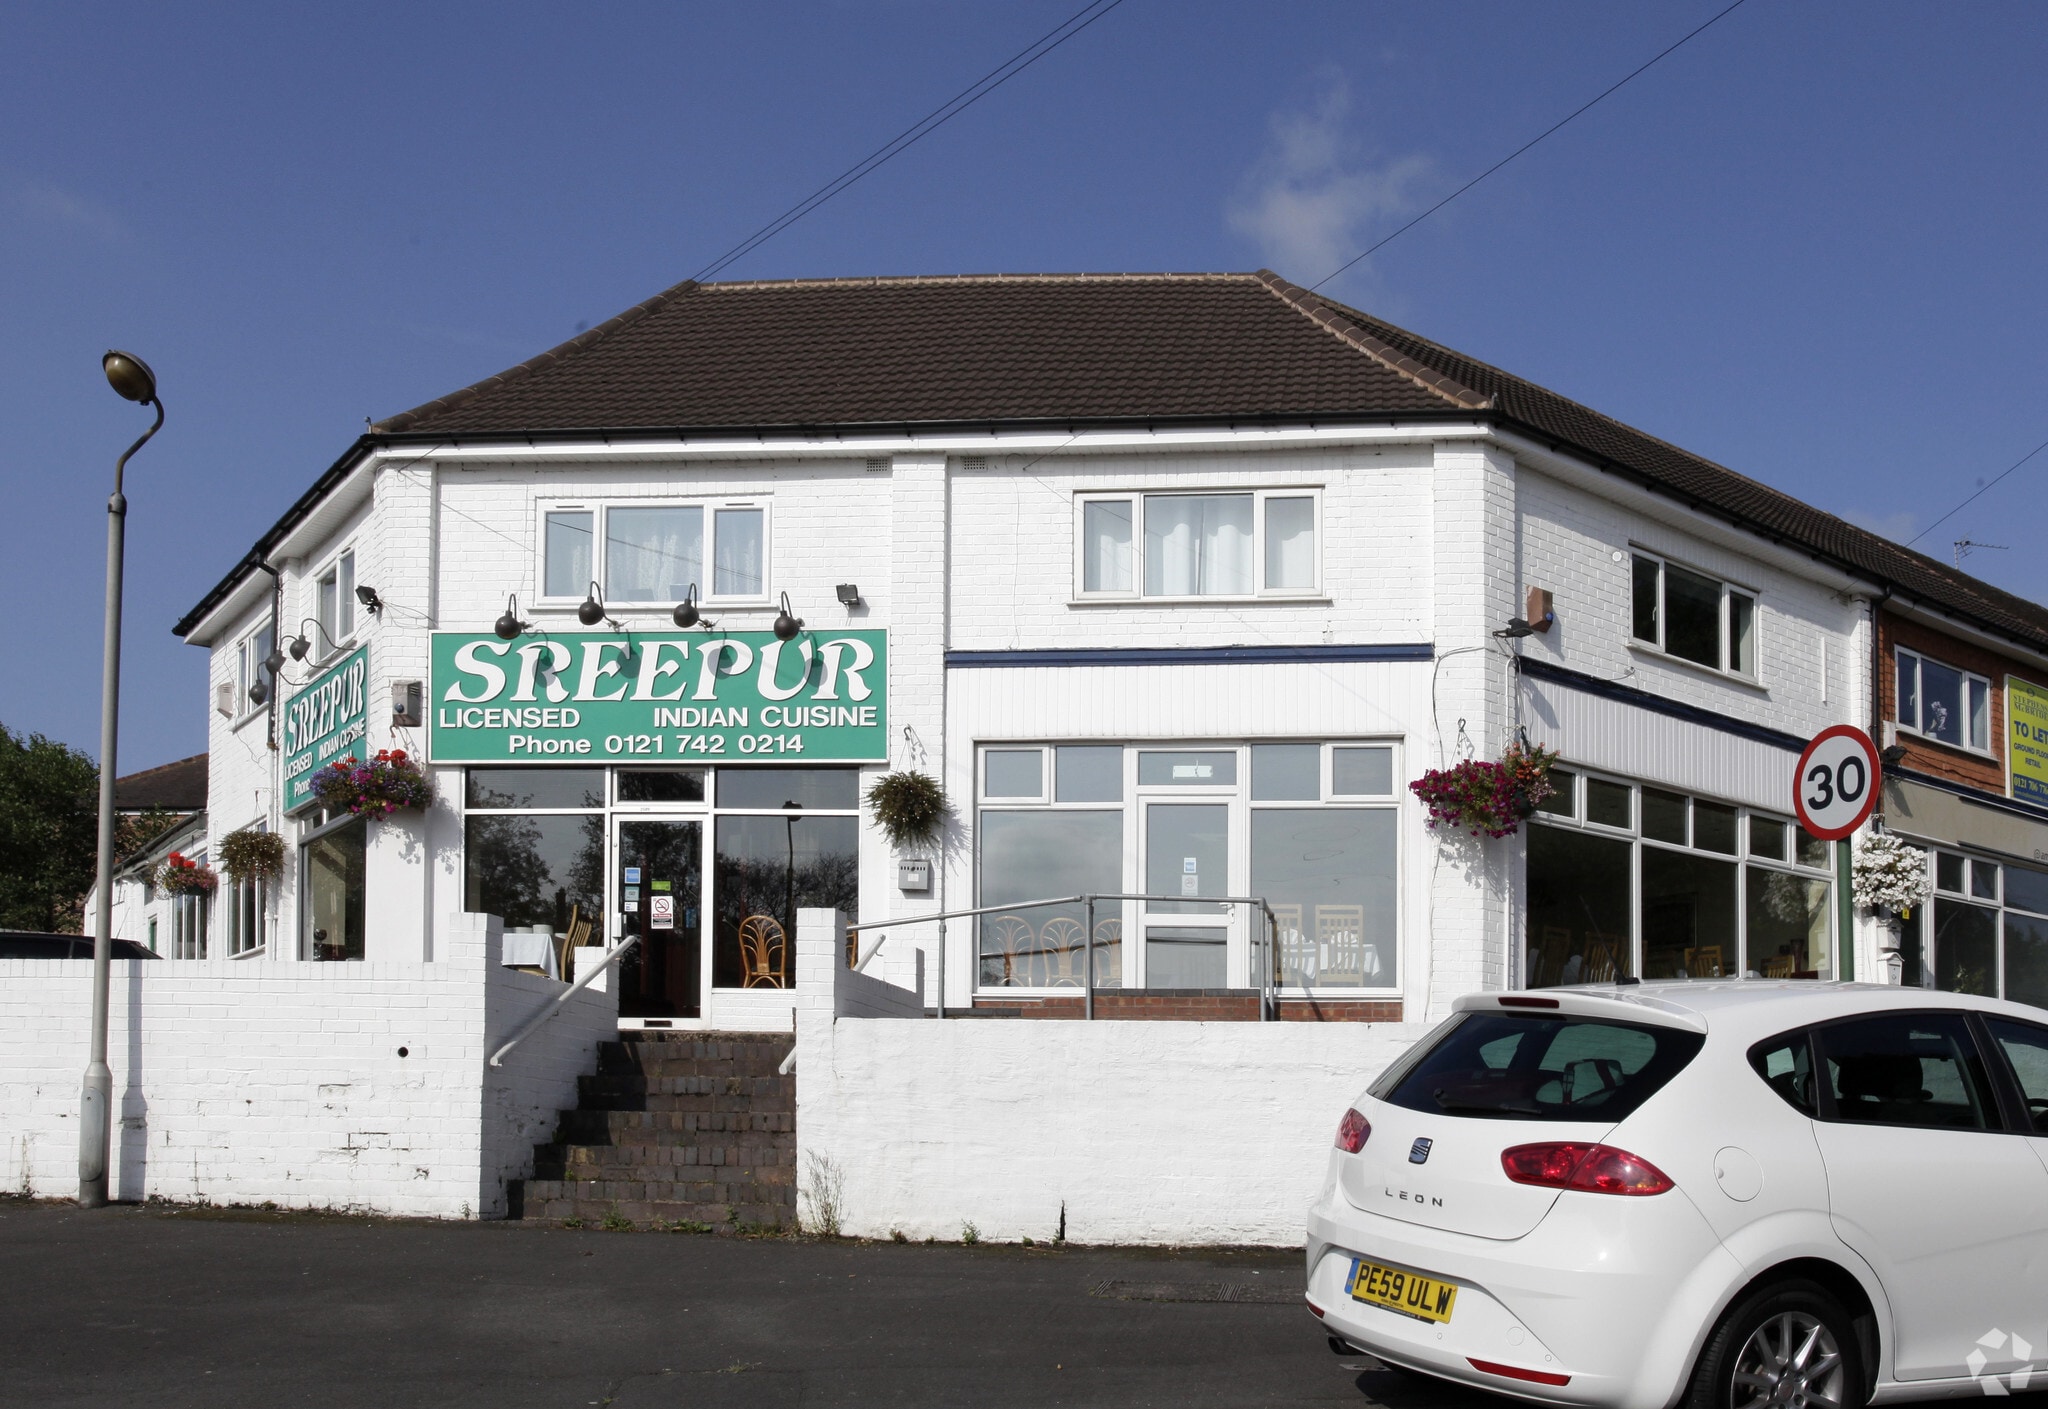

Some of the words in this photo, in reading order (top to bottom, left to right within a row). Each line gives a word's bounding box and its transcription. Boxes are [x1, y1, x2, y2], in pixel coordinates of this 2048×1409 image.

[444, 639, 875, 702] SREEPUR
[286, 657, 365, 758] SREEPUR
[439, 708, 581, 729] LICENSED
[654, 707, 748, 728] INDIAN
[760, 706, 878, 728] CUISINE
[509, 735, 592, 754] Phone
[605, 735, 663, 754] 0121
[676, 734, 725, 754] 742
[738, 734, 804, 754] 0214
[2013, 720, 2029, 738] TO
[2032, 726, 2048, 745] LET
[284, 751, 313, 781] LICENSED
[319, 734, 339, 762] INDIAN
[1807, 755, 1865, 810] 30
[1385, 1187, 1443, 1207] LEON
[1355, 1264, 1405, 1301] PE59
[1407, 1277, 1452, 1315] ULW
